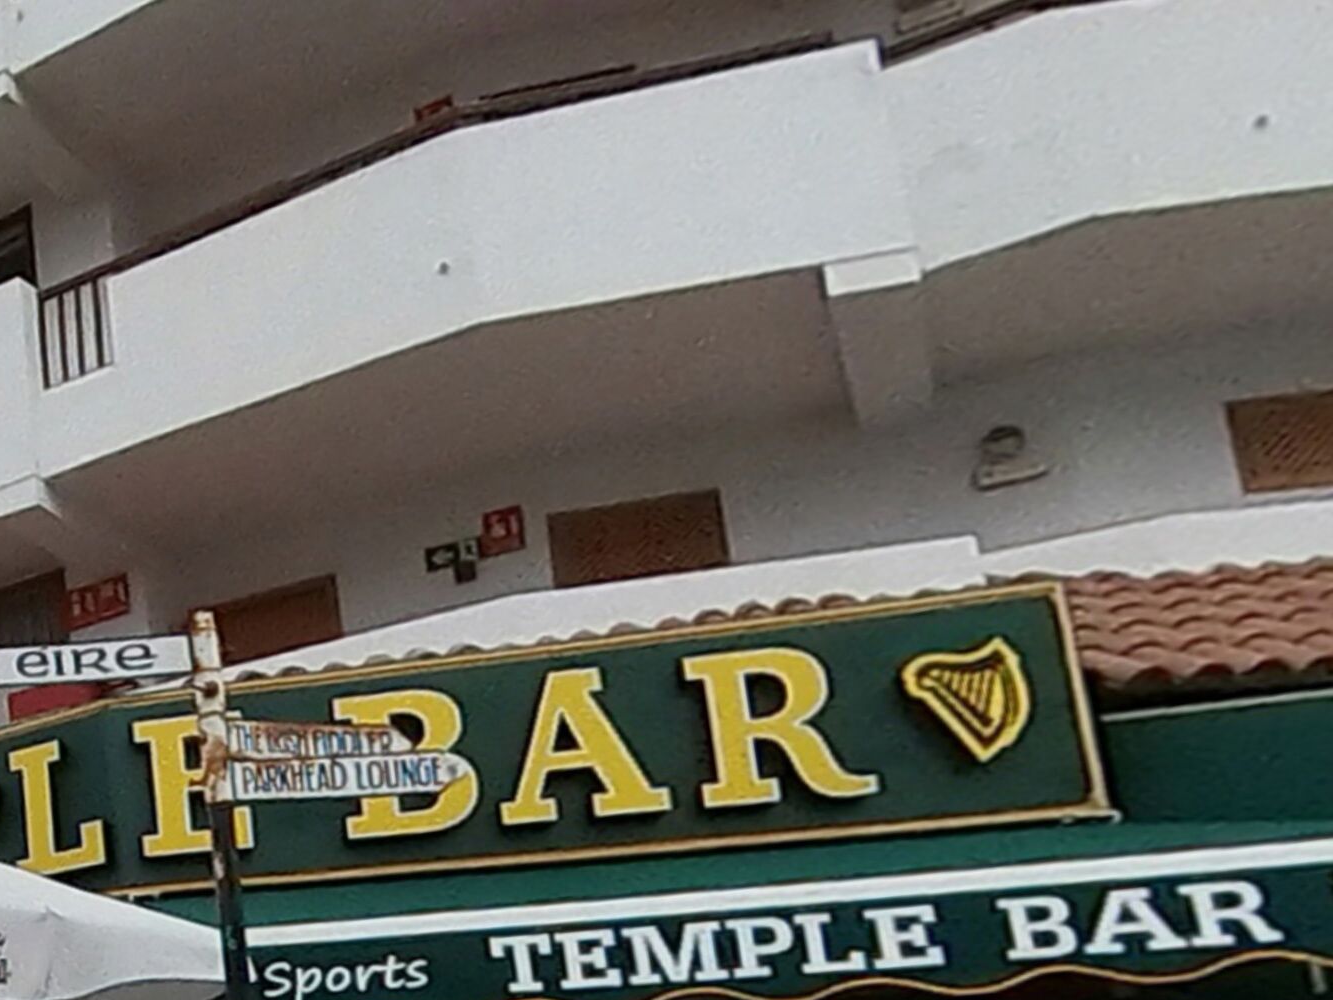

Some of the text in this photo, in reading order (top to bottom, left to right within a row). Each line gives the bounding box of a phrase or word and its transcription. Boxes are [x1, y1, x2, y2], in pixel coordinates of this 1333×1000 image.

[236, 724, 261, 753] THE
[242, 757, 444, 794] PARKHEAD LOUNGE
[333, 647, 882, 840] BAR
[488, 904, 947, 994] TEMPLE
[995, 880, 1285, 962] BAR
